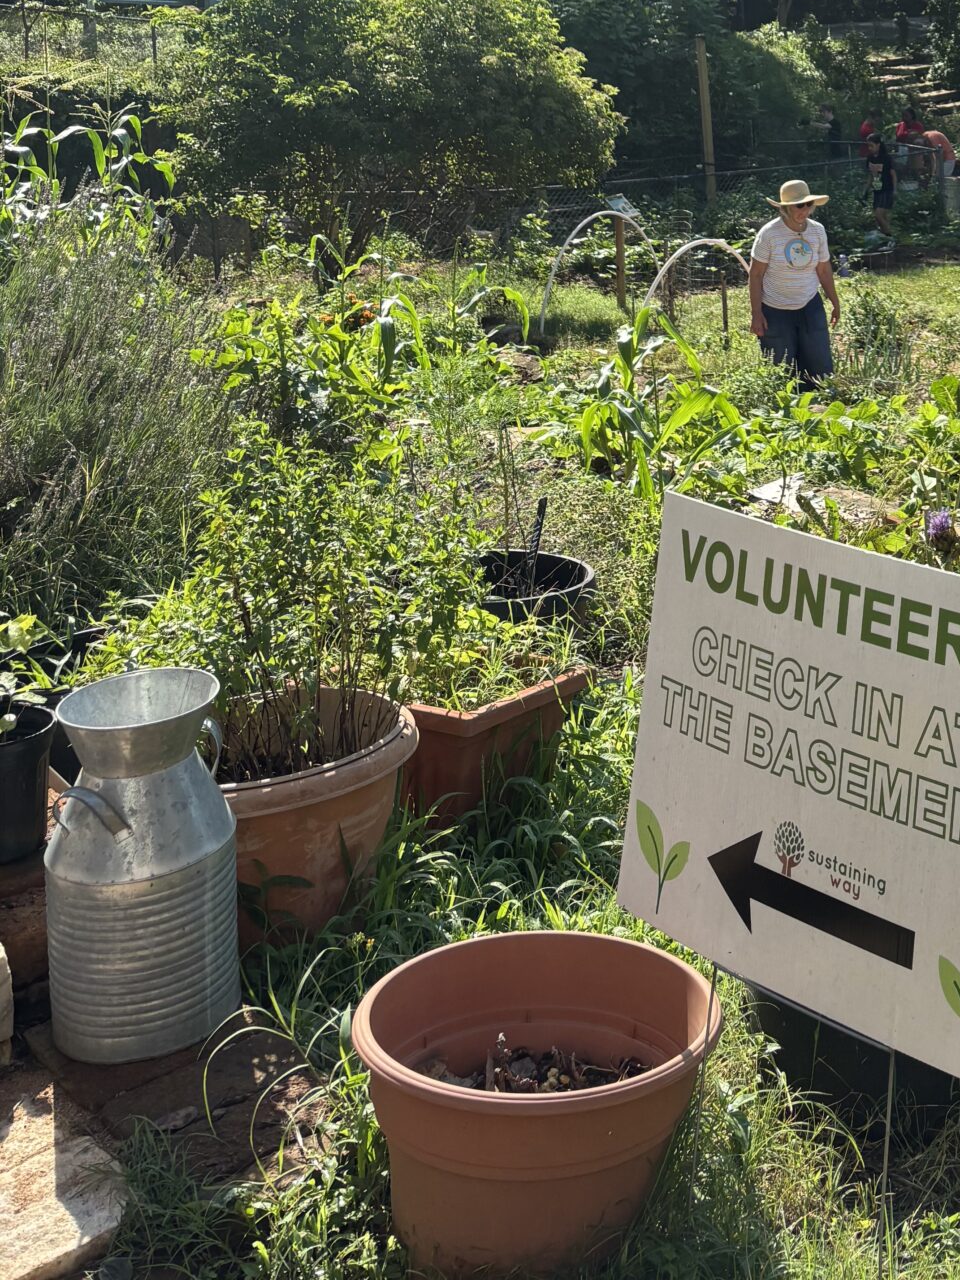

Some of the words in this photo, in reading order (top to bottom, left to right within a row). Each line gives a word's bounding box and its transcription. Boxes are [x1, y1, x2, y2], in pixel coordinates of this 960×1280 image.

[660, 676, 734, 753] THE
[692, 626, 843, 728] CHECK
[851, 681, 904, 749] IN
[807, 850, 887, 895] sustaining
[829, 874, 861, 901] way
